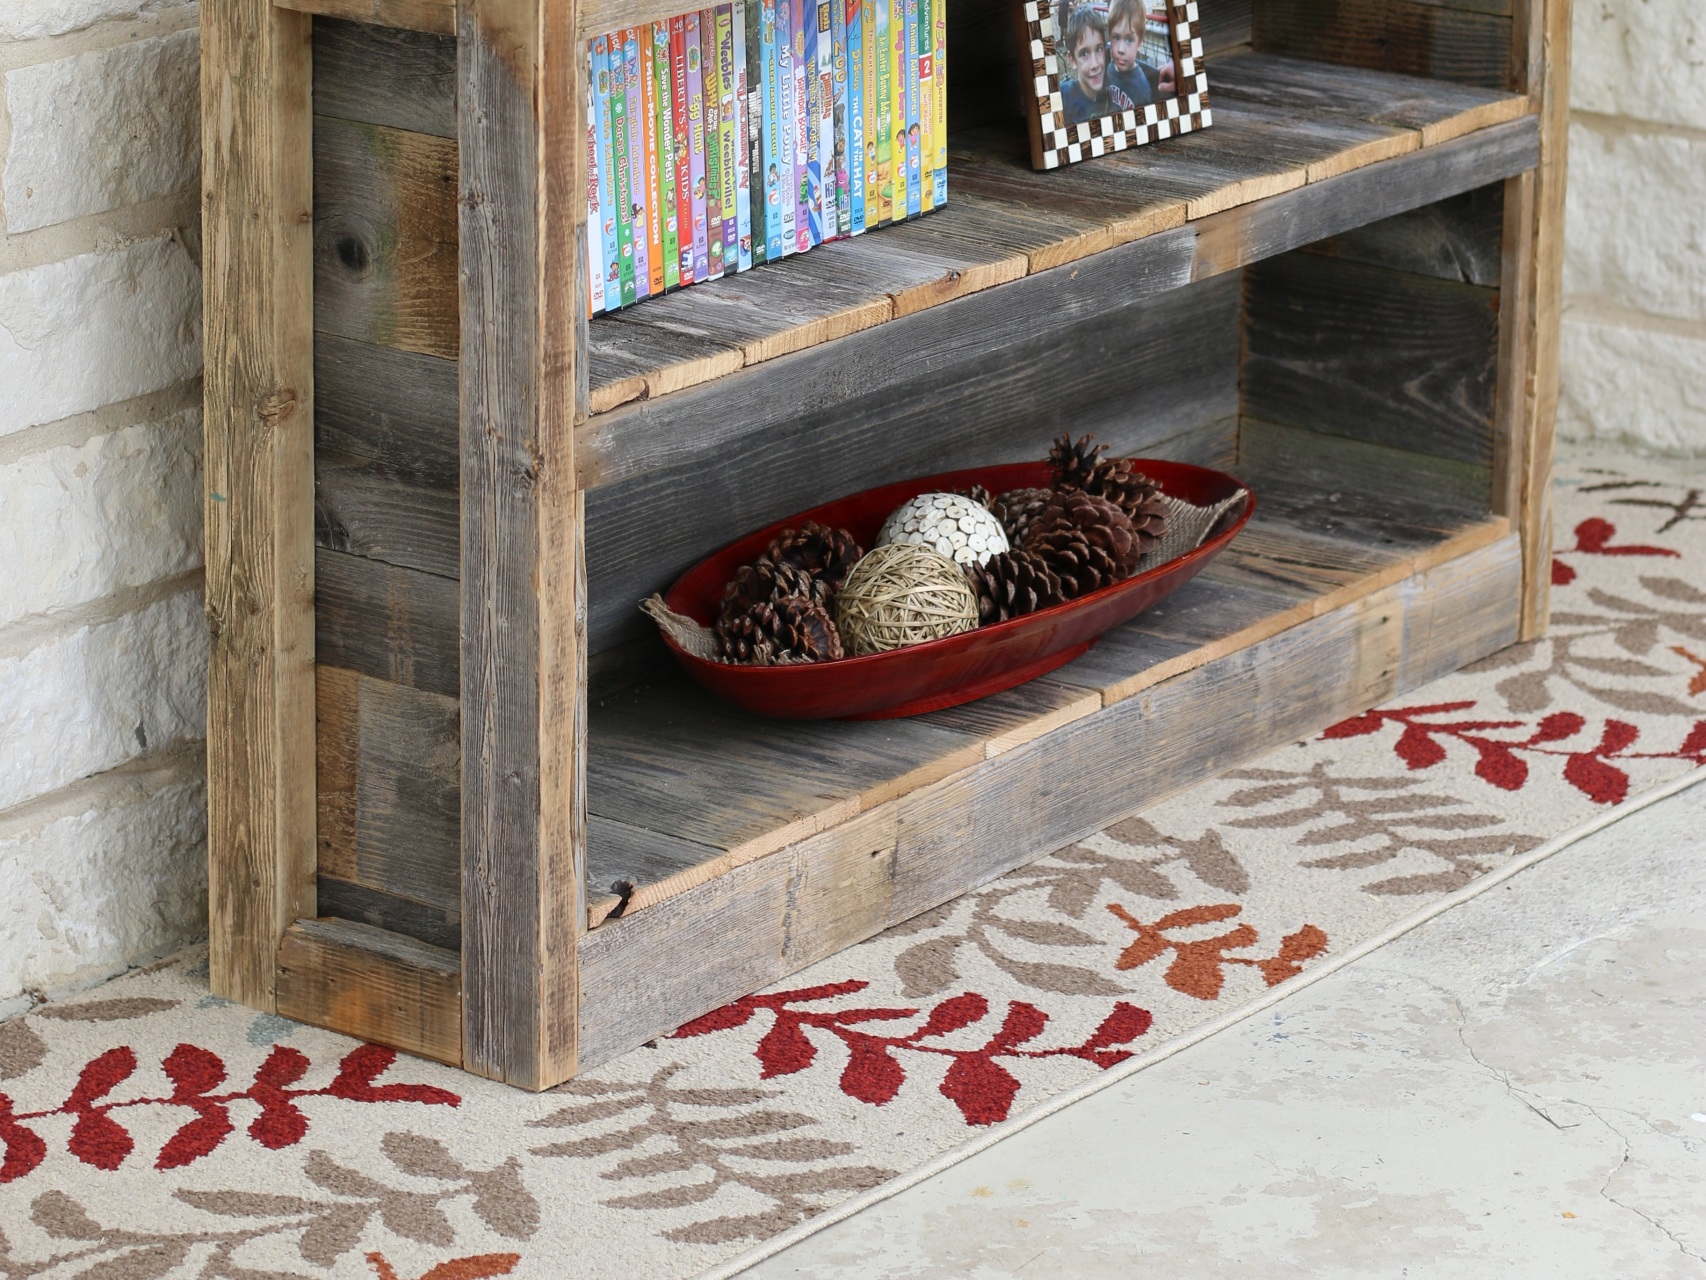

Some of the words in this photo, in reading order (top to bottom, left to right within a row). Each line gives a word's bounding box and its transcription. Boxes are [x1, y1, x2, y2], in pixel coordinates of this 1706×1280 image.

[674, 20, 684, 29] 40
[879, 37, 888, 47] An
[910, 22, 918, 55] Animal
[645, 46, 652, 57] 7
[720, 30, 731, 90] Weebles
[778, 44, 790, 68] My
[834, 36, 847, 83] ZOO
[879, 49, 888, 73] Easter
[923, 60, 931, 74] 2
[628, 57, 638, 91] DORA
[660, 68, 669, 91] Save
[676, 54, 687, 126] LIBERTY'S
[705, 72, 718, 108] WHY
[806, 56, 816, 108] WONDER
[853, 63, 862, 91] Seuss
[879, 73, 890, 99] Bunny
[911, 58, 919, 116] Adventures
[646, 62, 656, 153] MINI-MOVIE
[661, 92, 669, 106] the
[688, 93, 702, 121] Egg
[782, 74, 792, 120] Little
[820, 72, 832, 120] CHRISTMAS
[628, 97, 638, 142] Fairytale
[662, 107, 672, 151] Wonder
[748, 91, 759, 142] DINOSAURS
[853, 116, 863, 149] CAT
[880, 100, 891, 141] Adventure
[693, 122, 704, 154] Hunt
[781, 124, 792, 166] Pony
[798, 118, 807, 155] BOOGIE!
[808, 108, 818, 162] EMPORIUM
[631, 145, 641, 196] Adventure
[664, 153, 675, 184] Pets!
[723, 130, 733, 209] Weebleville!
[858, 151, 863, 162] IN
[588, 177, 599, 215] Rock
[618, 156, 632, 225] Christmas!
[649, 155, 659, 245] COLLECTION
[680, 165, 689, 200] KIDS
[853, 169, 863, 199] HAT
